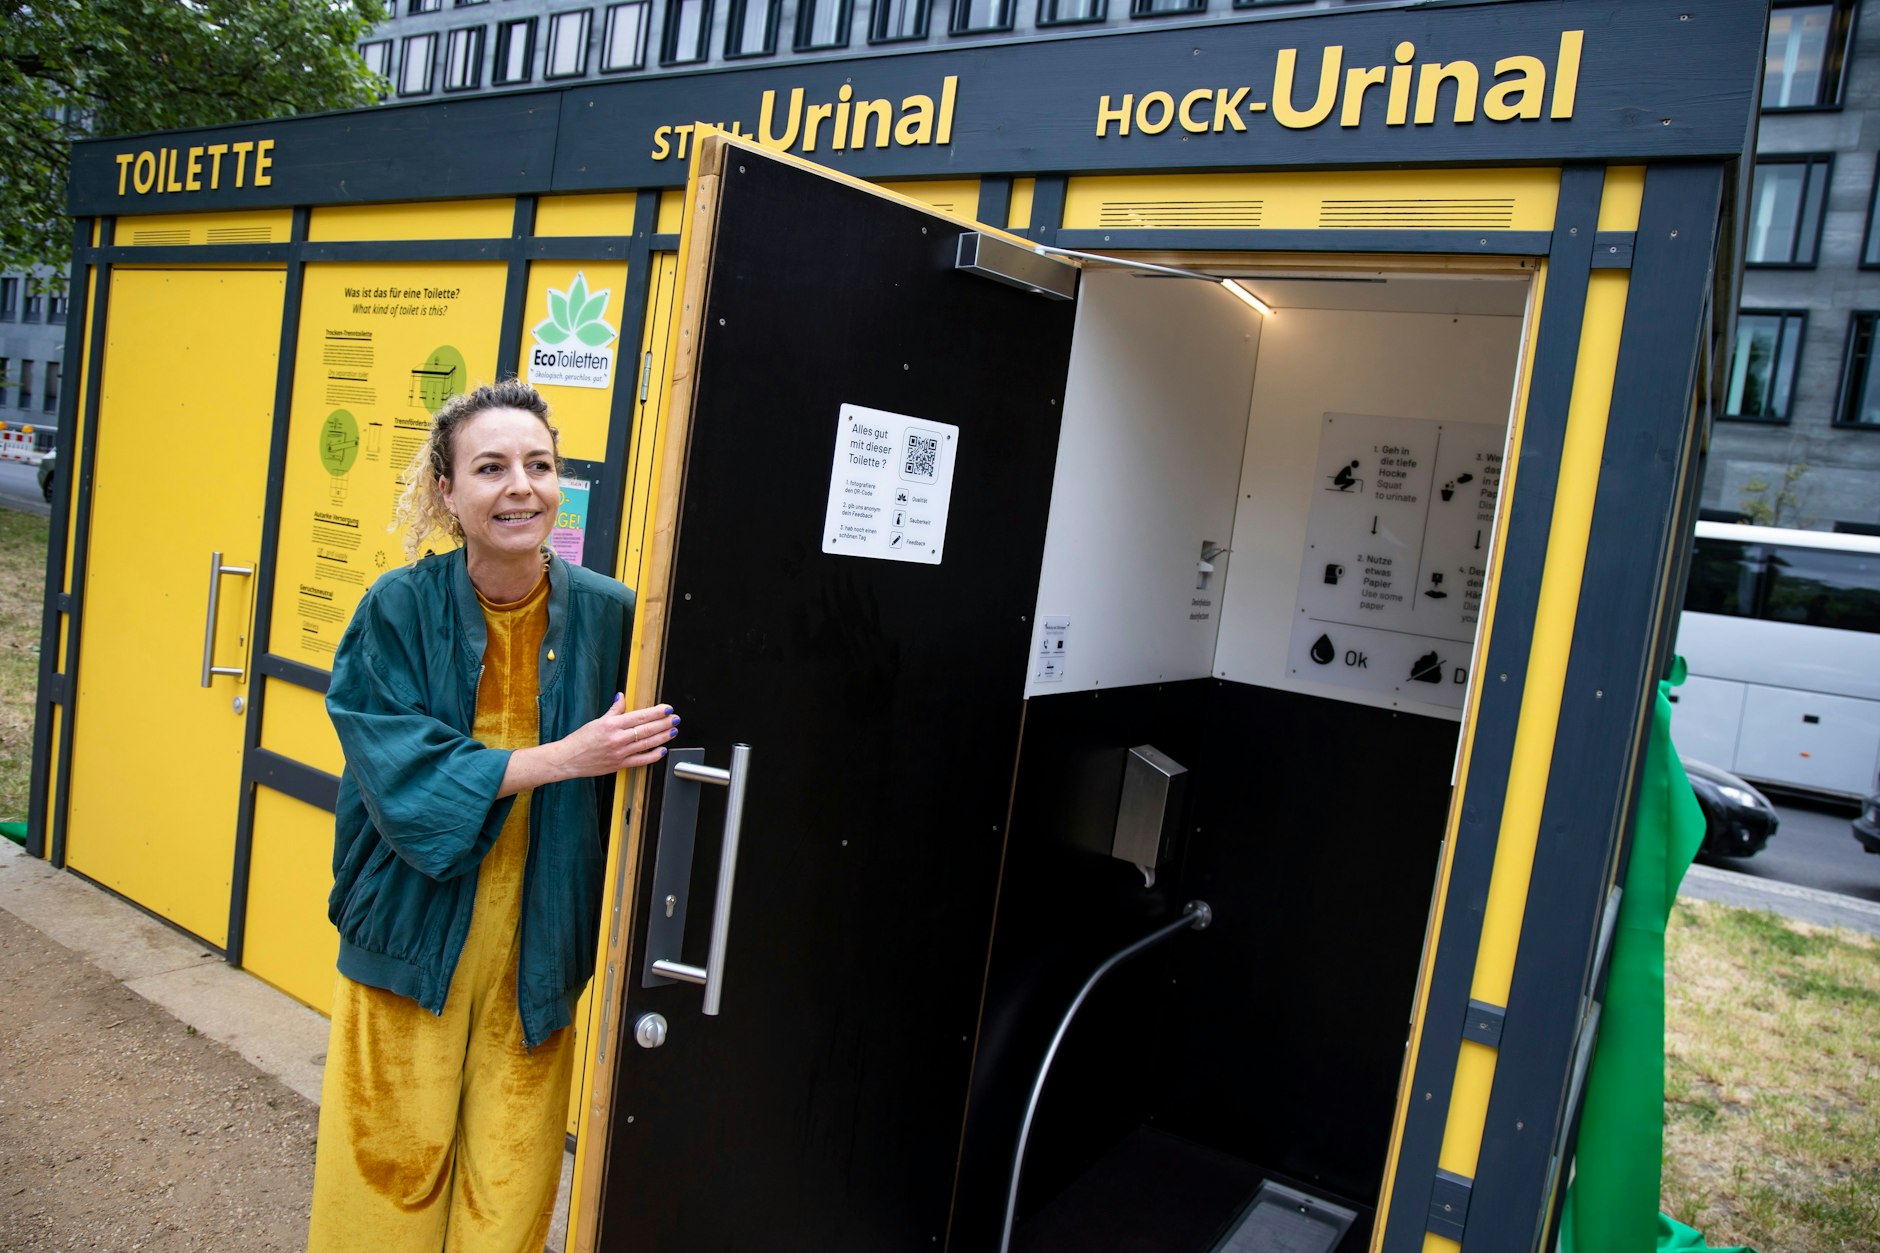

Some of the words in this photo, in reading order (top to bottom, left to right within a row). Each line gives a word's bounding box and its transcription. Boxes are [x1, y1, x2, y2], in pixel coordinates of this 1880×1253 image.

[1096, 30, 1584, 136] HOCK-Urinal
[652, 75, 958, 160] ST-Urinal
[116, 139, 274, 196] TOILETTE
[344, 288, 360, 298] Was
[362, 288, 371, 298] ist
[374, 288, 387, 298] das
[390, 288, 401, 298] für
[403, 288, 420, 298] eine
[424, 288, 460, 299] Toilette?
[352, 304, 370, 314] What
[372, 304, 388, 314] kind
[390, 304, 399, 318] of
[399, 305, 419, 315] toilet
[420, 306, 426, 316] is
[428, 305, 448, 316] this?
[534, 350, 608, 370] EcoToiletten
[852, 424, 872, 436] Alles
[874, 430, 888, 439] gut
[850, 440, 864, 450] mit
[866, 442, 892, 454] dieser
[1382, 445, 1400, 455] Geh
[1401, 447, 1410, 455] in
[849, 453, 880, 467] Toilette
[882, 459, 886, 468] ?
[1380, 457, 1394, 466] die
[1396, 458, 1417, 468] tiefe
[1379, 468, 1407, 478] Hocke
[1377, 480, 1402, 490] Squat
[1386, 493, 1417, 502] urinate
[1367, 554, 1392, 566] Nutze
[1365, 568, 1391, 577] etwas
[1363, 577, 1392, 588] Papier
[1362, 589, 1378, 599] Use
[1380, 593, 1403, 602] some
[1360, 601, 1384, 611] paper
[1345, 650, 1368, 669] Ok
